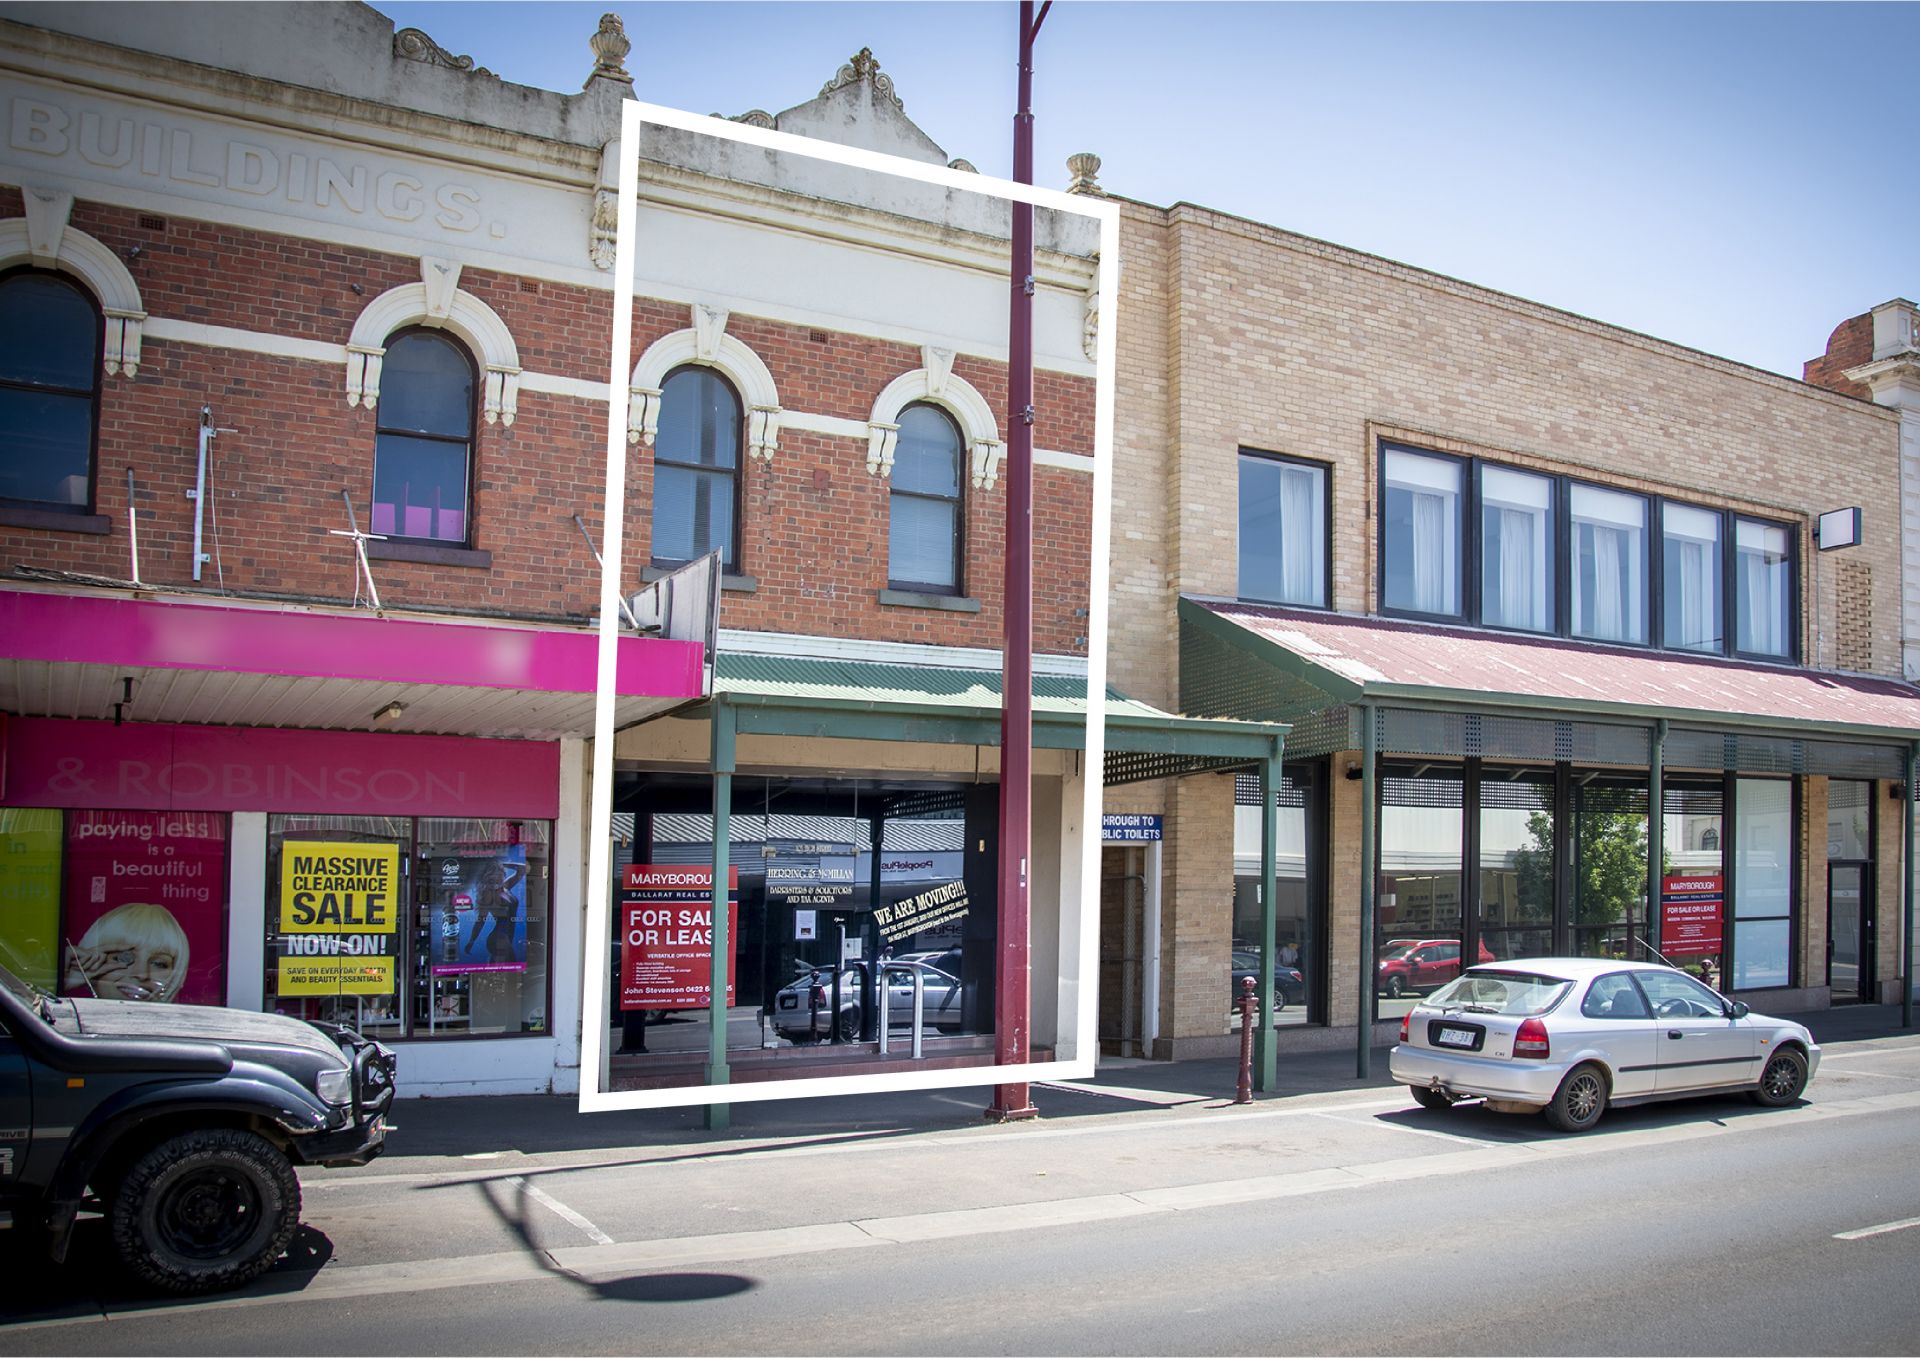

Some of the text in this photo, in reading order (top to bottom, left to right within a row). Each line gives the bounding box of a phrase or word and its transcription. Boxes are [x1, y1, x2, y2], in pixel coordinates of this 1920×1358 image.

[8, 99, 505, 239] BUILDINGS.
[47, 757, 465, 805] & ROBINSON
[1103, 815, 1154, 826] HROUGH TO
[79, 817, 209, 841] paying less
[1102, 829, 1161, 839] BLIC TOILETS
[148, 843, 174, 855] is a
[112, 860, 202, 877] beautiful
[293, 856, 388, 877] MASSIVE
[768, 868, 807, 879] HERRING
[807, 868, 816, 879] &
[292, 876, 388, 892] CLEARANCE
[631, 873, 713, 885] MARYBOROU
[1670, 881, 1715, 890] MARYBOROUGH
[162, 883, 209, 901] thing
[769, 886, 853, 895] BARRISTERS & SOLICITORS
[786, 895, 835, 904] AND TAX AGENTS
[873, 906, 893, 926] WE
[894, 898, 916, 920] ARE
[915, 880, 967, 911] MOVING!!!
[292, 892, 386, 925] SALE
[1692, 905, 1701, 913] OR
[630, 910, 730, 926] FOR SAL
[287, 934, 387, 955] NOW ON!
[628, 929, 729, 946] OR LEAS
[287, 967, 306, 975] SAVE
[308, 967, 319, 975] ON
[320, 967, 357, 975] EVERYDAY
[290, 975, 383, 984] AND BEAUTY ESSENTIALS
[624, 987, 644, 995] John
[645, 986, 684, 994] Stevenson
[685, 985, 704, 993] 0422
